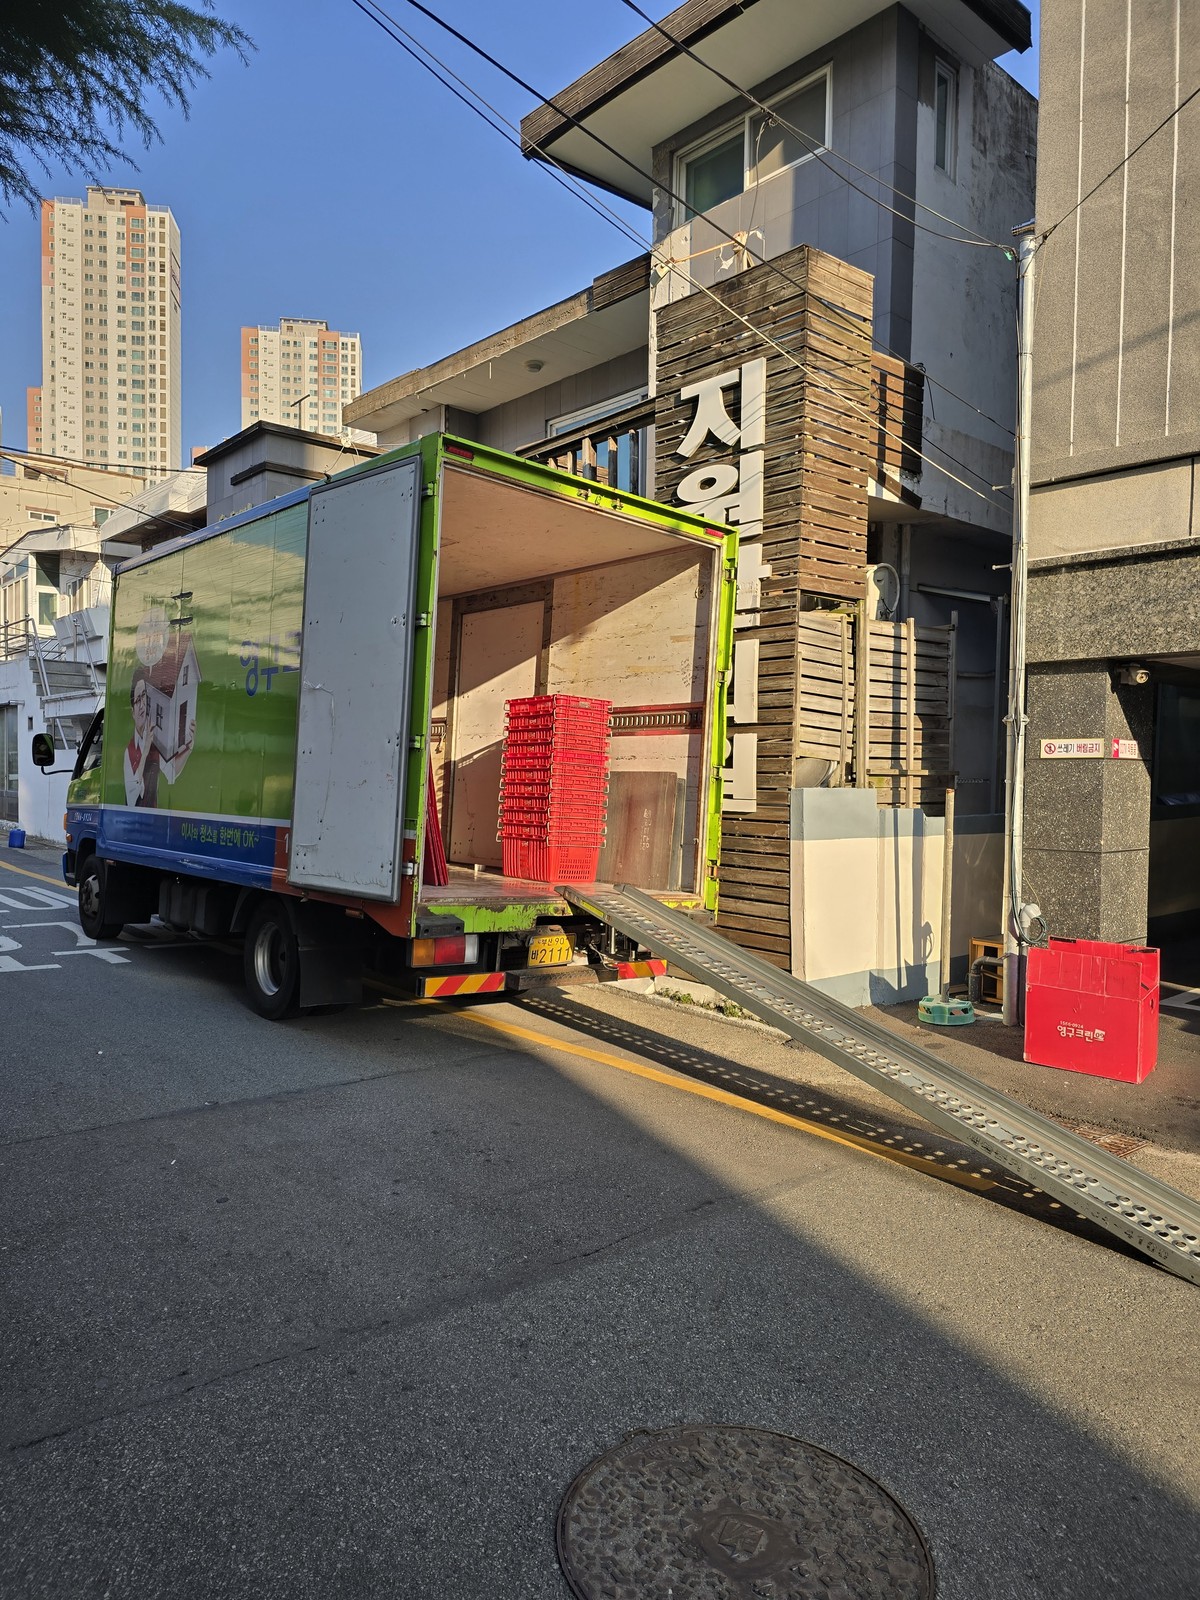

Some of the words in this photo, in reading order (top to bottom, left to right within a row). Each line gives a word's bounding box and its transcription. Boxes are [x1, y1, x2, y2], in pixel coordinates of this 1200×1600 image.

[1057, 742, 1075, 754] 쓰레기
[181, 822, 199, 841] 이사와
[200, 824, 218, 844] 청소를
[219, 826, 240, 848] 한번에
